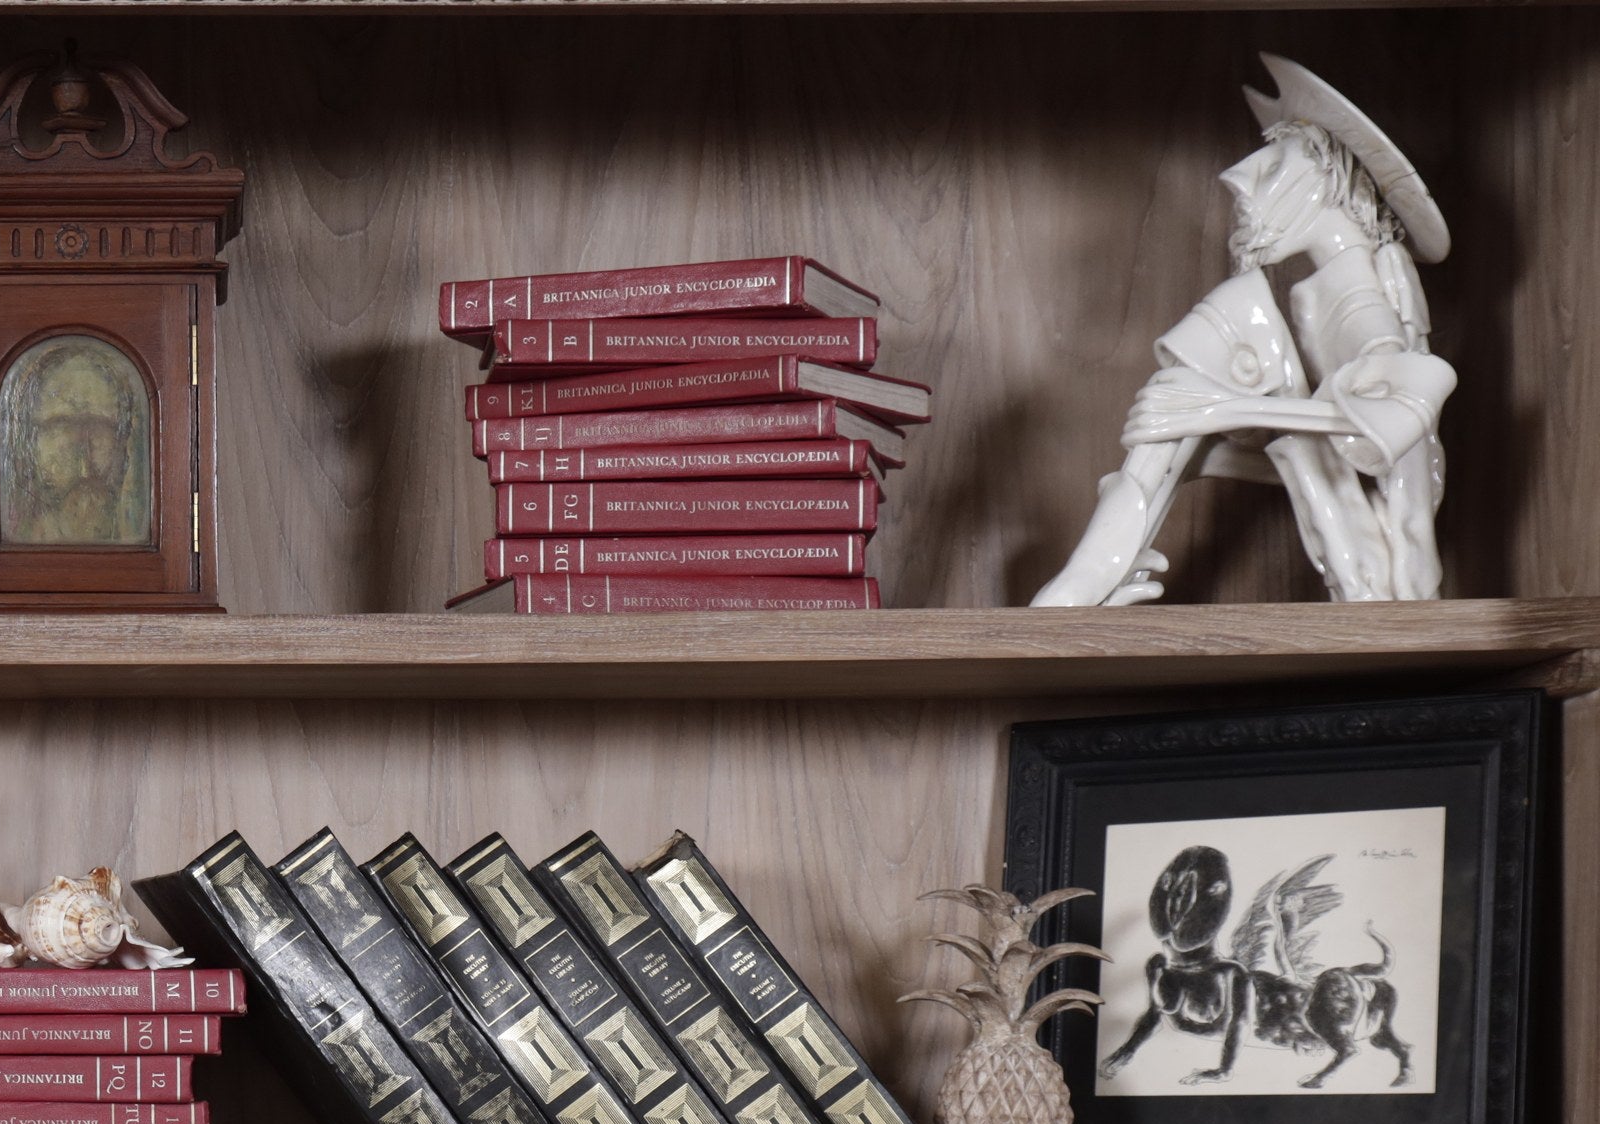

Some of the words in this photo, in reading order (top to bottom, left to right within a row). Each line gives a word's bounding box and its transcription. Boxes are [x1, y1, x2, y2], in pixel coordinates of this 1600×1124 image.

[543, 288, 620, 304] BRITANNICA
[623, 284, 671, 299] JUNIOR
[676, 276, 777, 294] ENCYCLOPÆDIA
[465, 300, 478, 310] 2
[504, 294, 517, 308] A
[523, 336, 537, 345] 3
[563, 336, 578, 346] B
[606, 336, 687, 346] BRITANNICA
[690, 335, 741, 349] JUNIOR
[746, 335, 850, 346] ENCYCLOPÆDIA
[487, 395, 499, 405] 9
[521, 381, 534, 412] KL
[498, 432, 511, 441] 8
[515, 460, 529, 469] 7
[556, 457, 570, 471] H
[597, 456, 677, 468] BRITANNICA
[680, 455, 731, 469] JUNIOR
[736, 451, 840, 464] ENCYCLOPÆDIA
[523, 502, 537, 511] 6
[564, 494, 579, 520] FG
[606, 501, 687, 511] BRITANNICA
[690, 501, 741, 514] JUNIOR
[746, 500, 849, 510] ENCYCLOPÆDIA
[515, 554, 529, 563] 5
[555, 543, 569, 572] DE
[597, 551, 677, 562] BRITANNICA
[680, 550, 730, 564] JUNIOR
[735, 548, 839, 560] ENCYCLOPÆDIA
[543, 595, 556, 605] 4
[582, 595, 596, 608] C
[9, 984, 57, 997] JUNIOR
[61, 985, 139, 996] BRITANNICA
[166, 982, 180, 998] M
[206, 981, 219, 998] 10
[31, 1029, 111, 1040] BRITANNICA
[138, 1020, 153, 1050] NO
[179, 1029, 193, 1044] 11
[4, 1073, 84, 1084] BRITANNICA
[106, 1064, 126, 1094] PQ
[151, 1072, 166, 1088] 12
